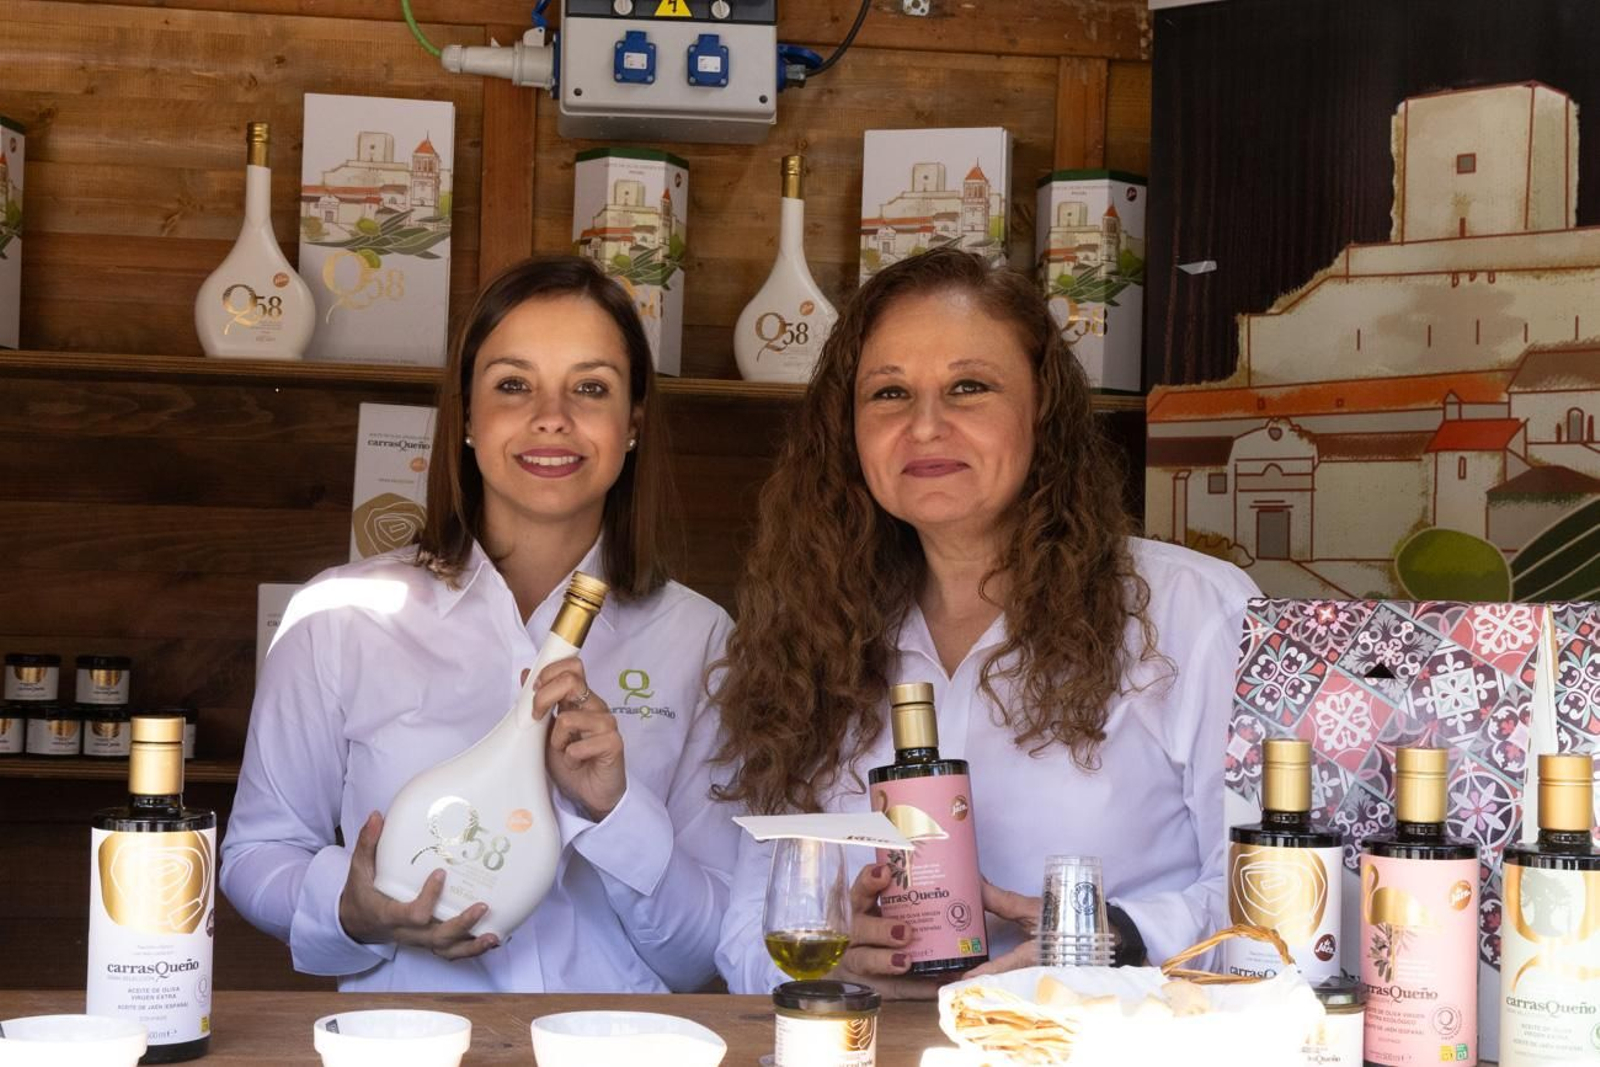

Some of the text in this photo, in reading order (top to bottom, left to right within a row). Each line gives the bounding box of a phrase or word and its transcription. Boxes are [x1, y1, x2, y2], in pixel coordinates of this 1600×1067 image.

[222, 284, 282, 336] Q58
[756, 312, 809, 362] Q58
[367, 440, 431, 452] carrasQueño
[618, 668, 656, 706] Q
[410, 796, 512, 871] Q58
[107, 958, 200, 983] carrasQueño
[1230, 966, 1278, 979] carrasQ
[1505, 995, 1597, 1019] carrasQueño
